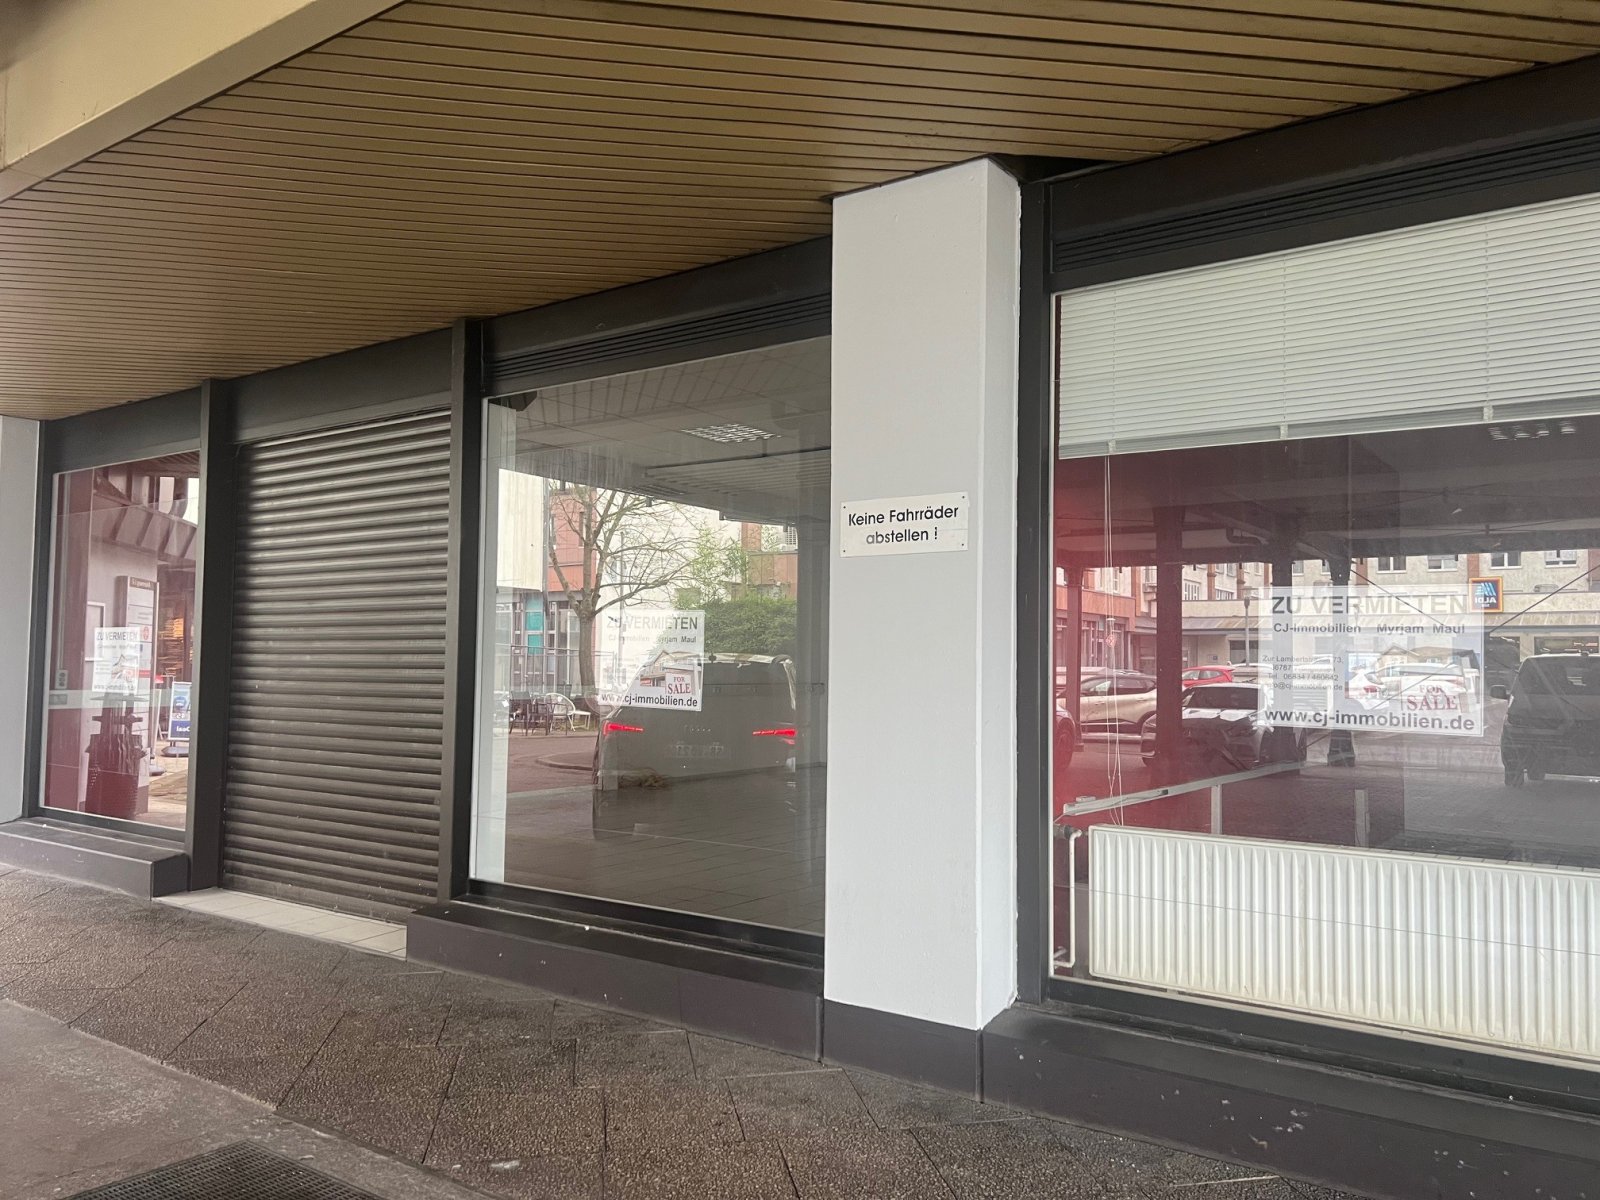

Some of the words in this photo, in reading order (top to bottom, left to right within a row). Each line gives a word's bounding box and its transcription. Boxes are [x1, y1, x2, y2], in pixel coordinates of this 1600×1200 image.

[848, 512, 885, 526] Keine
[889, 505, 959, 523] Fahrräder
[866, 528, 929, 545] abstellen
[1271, 596, 1301, 614] ZU
[1311, 594, 1468, 614] VERMIETEN
[625, 615, 698, 630] VERMIETEN
[1376, 623, 1424, 635] Myrjam
[1432, 623, 1465, 634] Maul
[680, 635, 697, 644] Maul
[667, 683, 691, 695] SALE
[1419, 684, 1443, 694] FOR
[1407, 694, 1458, 711] SALE
[1264, 709, 1475, 731] www.cj-immobilien.de
